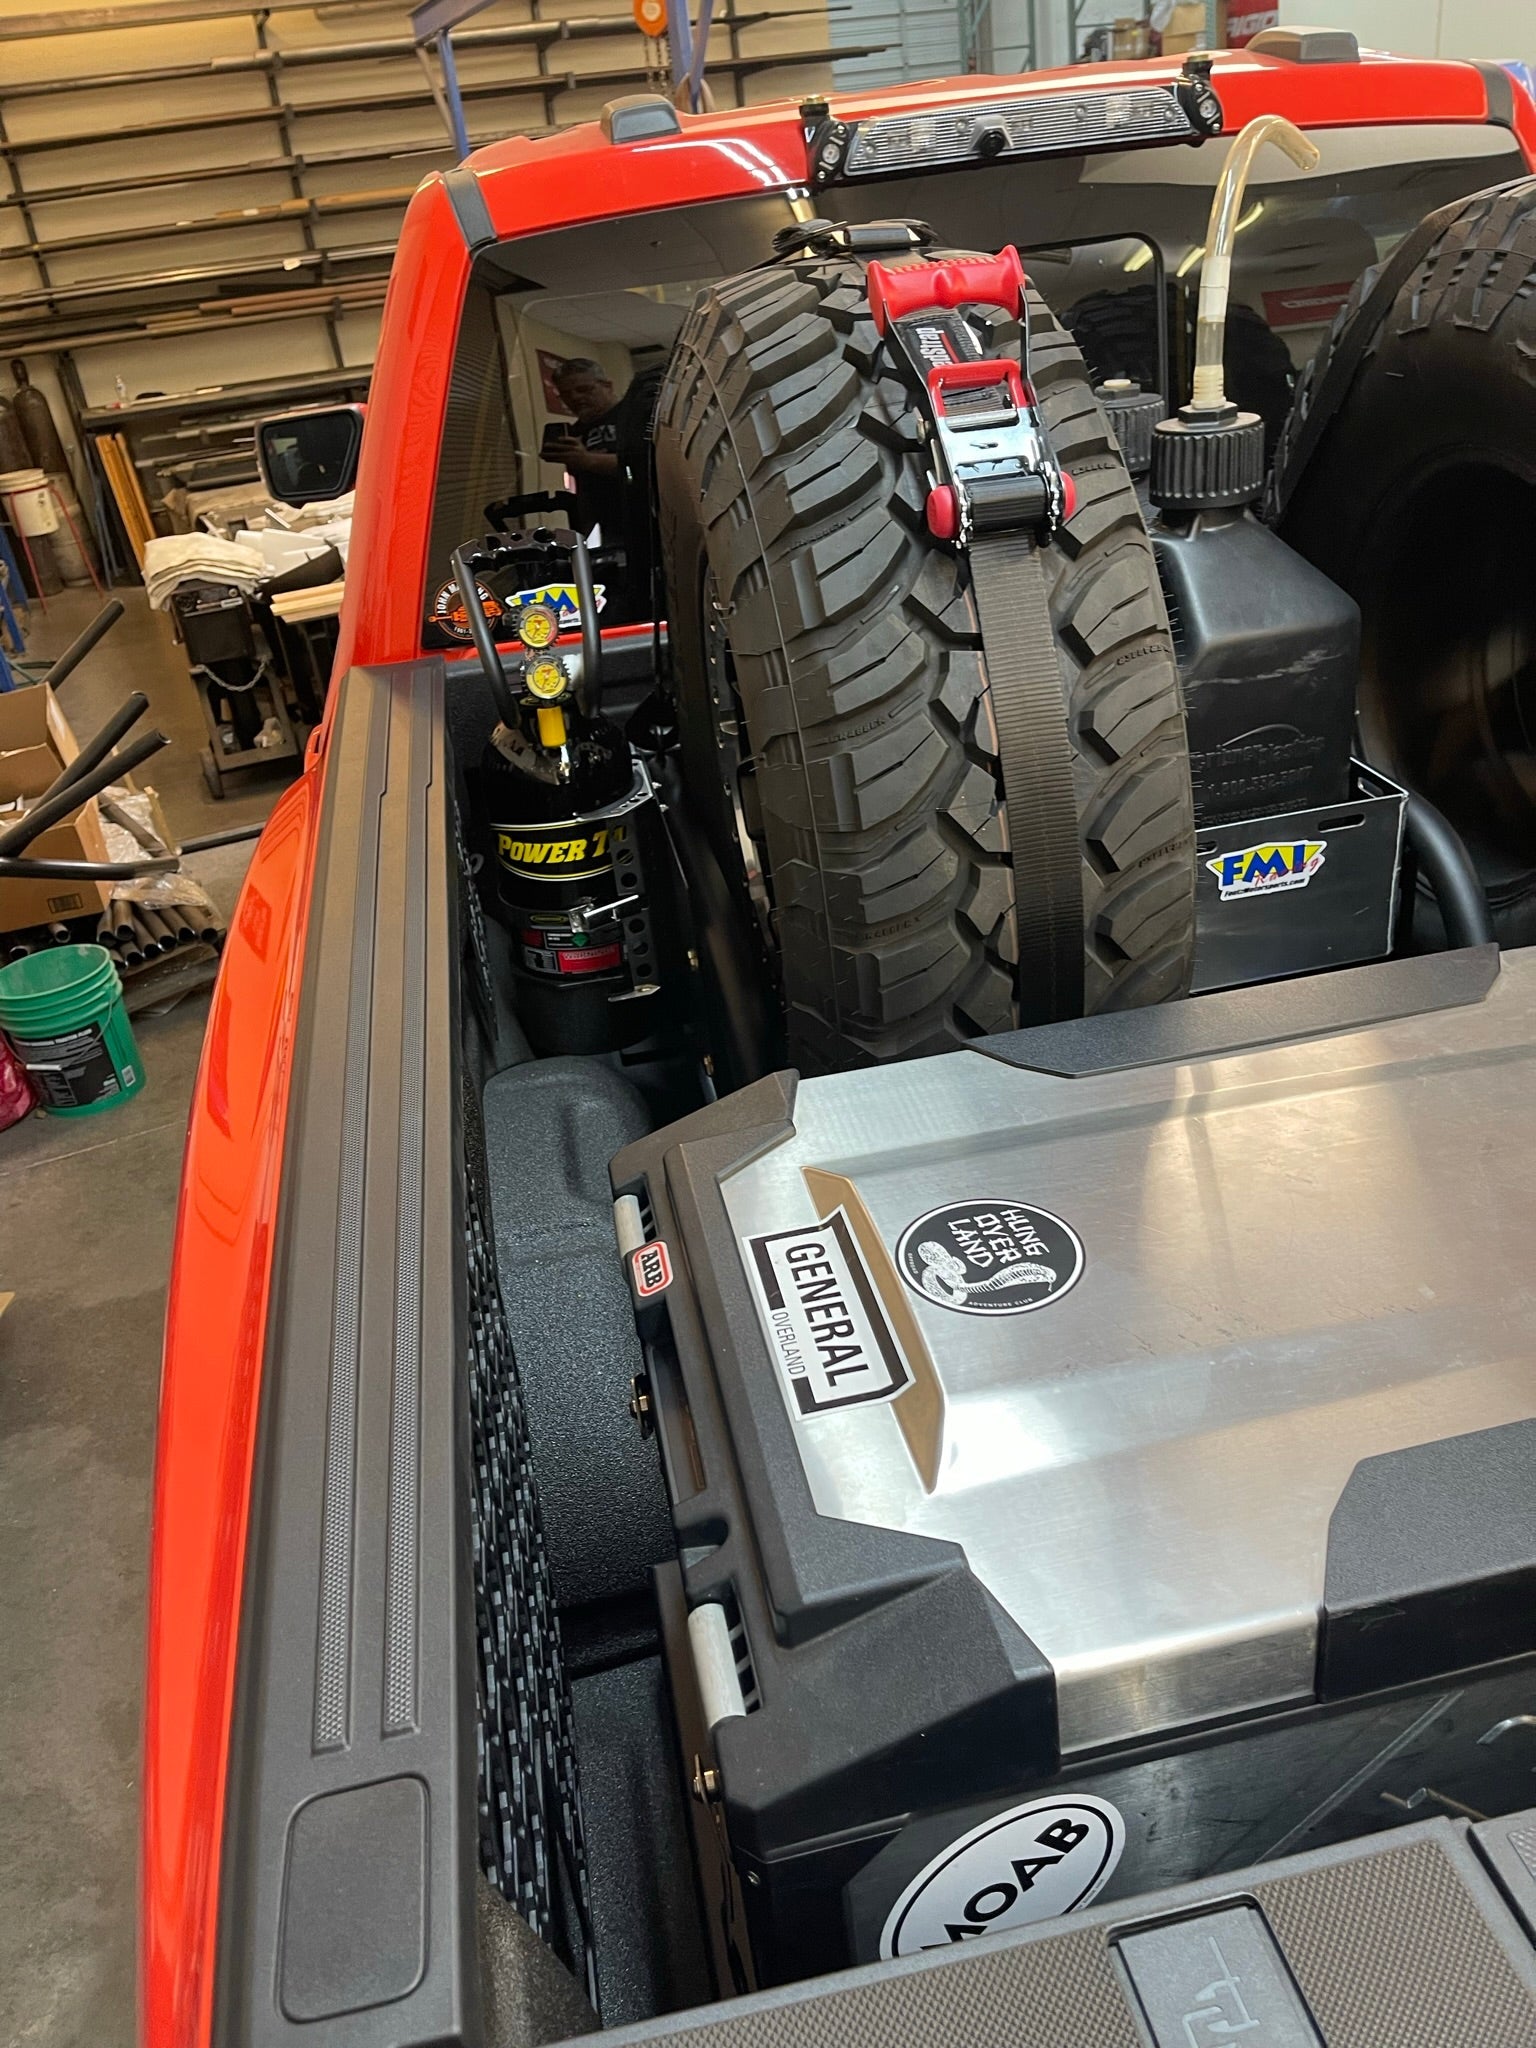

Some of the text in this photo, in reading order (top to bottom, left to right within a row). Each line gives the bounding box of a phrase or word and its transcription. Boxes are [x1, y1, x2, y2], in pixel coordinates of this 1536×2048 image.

[916, 327, 954, 368] edStrap
[437, 591, 450, 614] JOHN
[498, 833, 588, 864] POWER
[1222, 844, 1306, 887] FMI
[948, 1218, 994, 1268] LAND
[973, 1213, 1023, 1264] OVER
[1000, 1209, 1050, 1257] HUNG
[641, 1249, 663, 1288] ARB
[785, 1242, 870, 1388] GENERAL
[772, 1311, 806, 1375] OVERLAND
